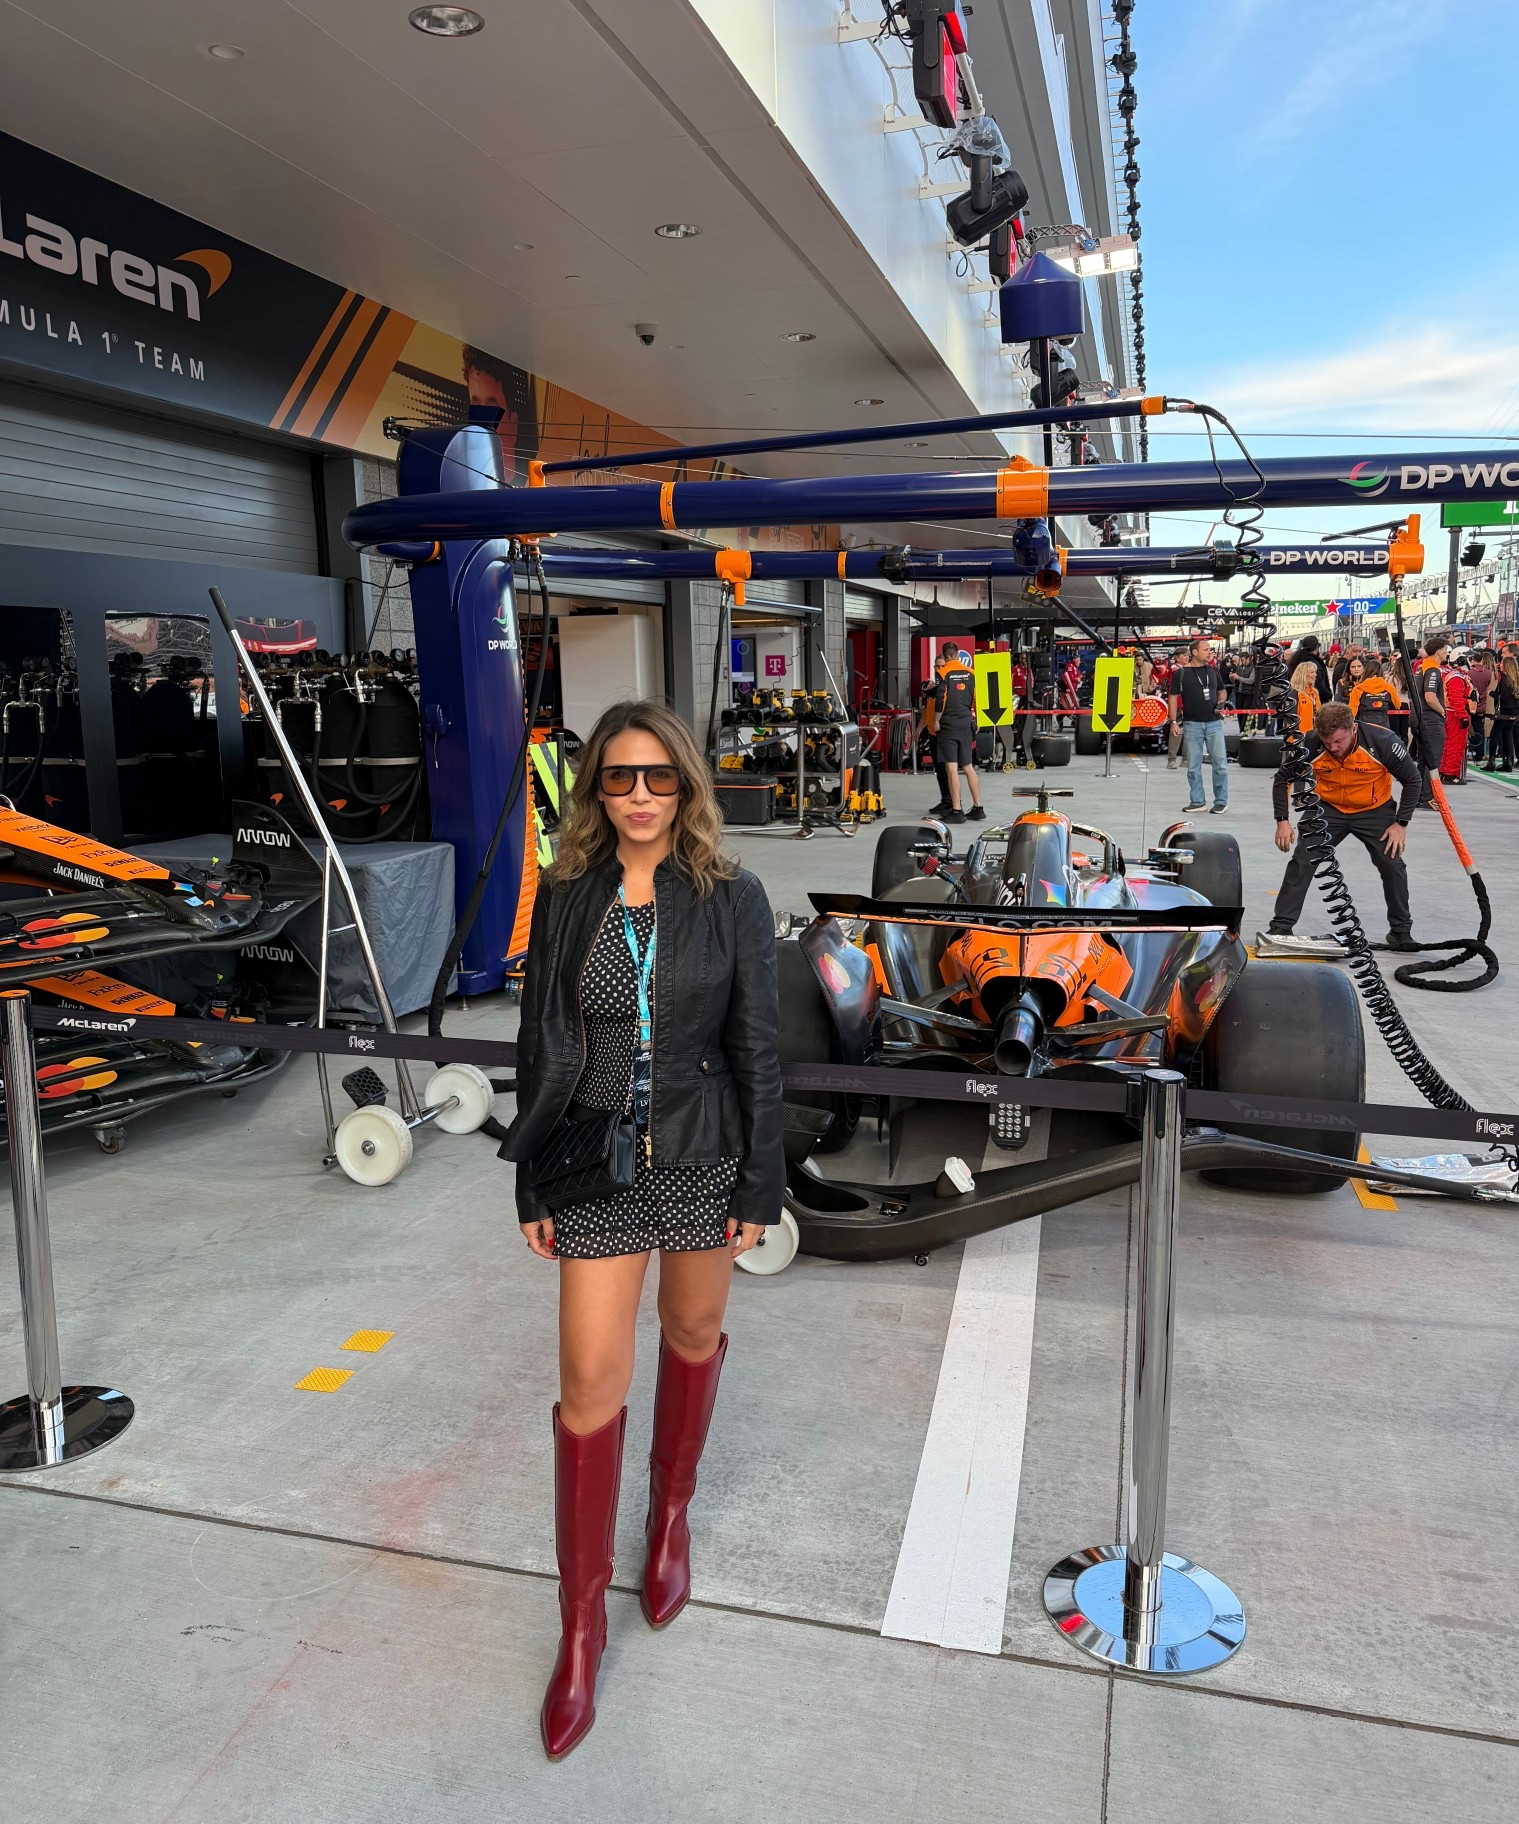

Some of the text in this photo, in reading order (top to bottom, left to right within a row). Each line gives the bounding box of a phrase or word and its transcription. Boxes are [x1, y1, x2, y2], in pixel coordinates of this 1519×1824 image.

[135, 341, 205, 381] TEAM
[1400, 464, 1454, 490] DP
[1270, 550, 1389, 565] DP WORLD
[1263, 601, 1320, 614] eineken
[488, 640, 518, 650] DP WORLD
[53, 862, 105, 889] JACK DANIEL'S
[57, 1017, 129, 1032] McLaren
[348, 1035, 375, 1051] flex
[965, 1079, 998, 1097] flex
[1475, 1118, 1514, 1138] flex
